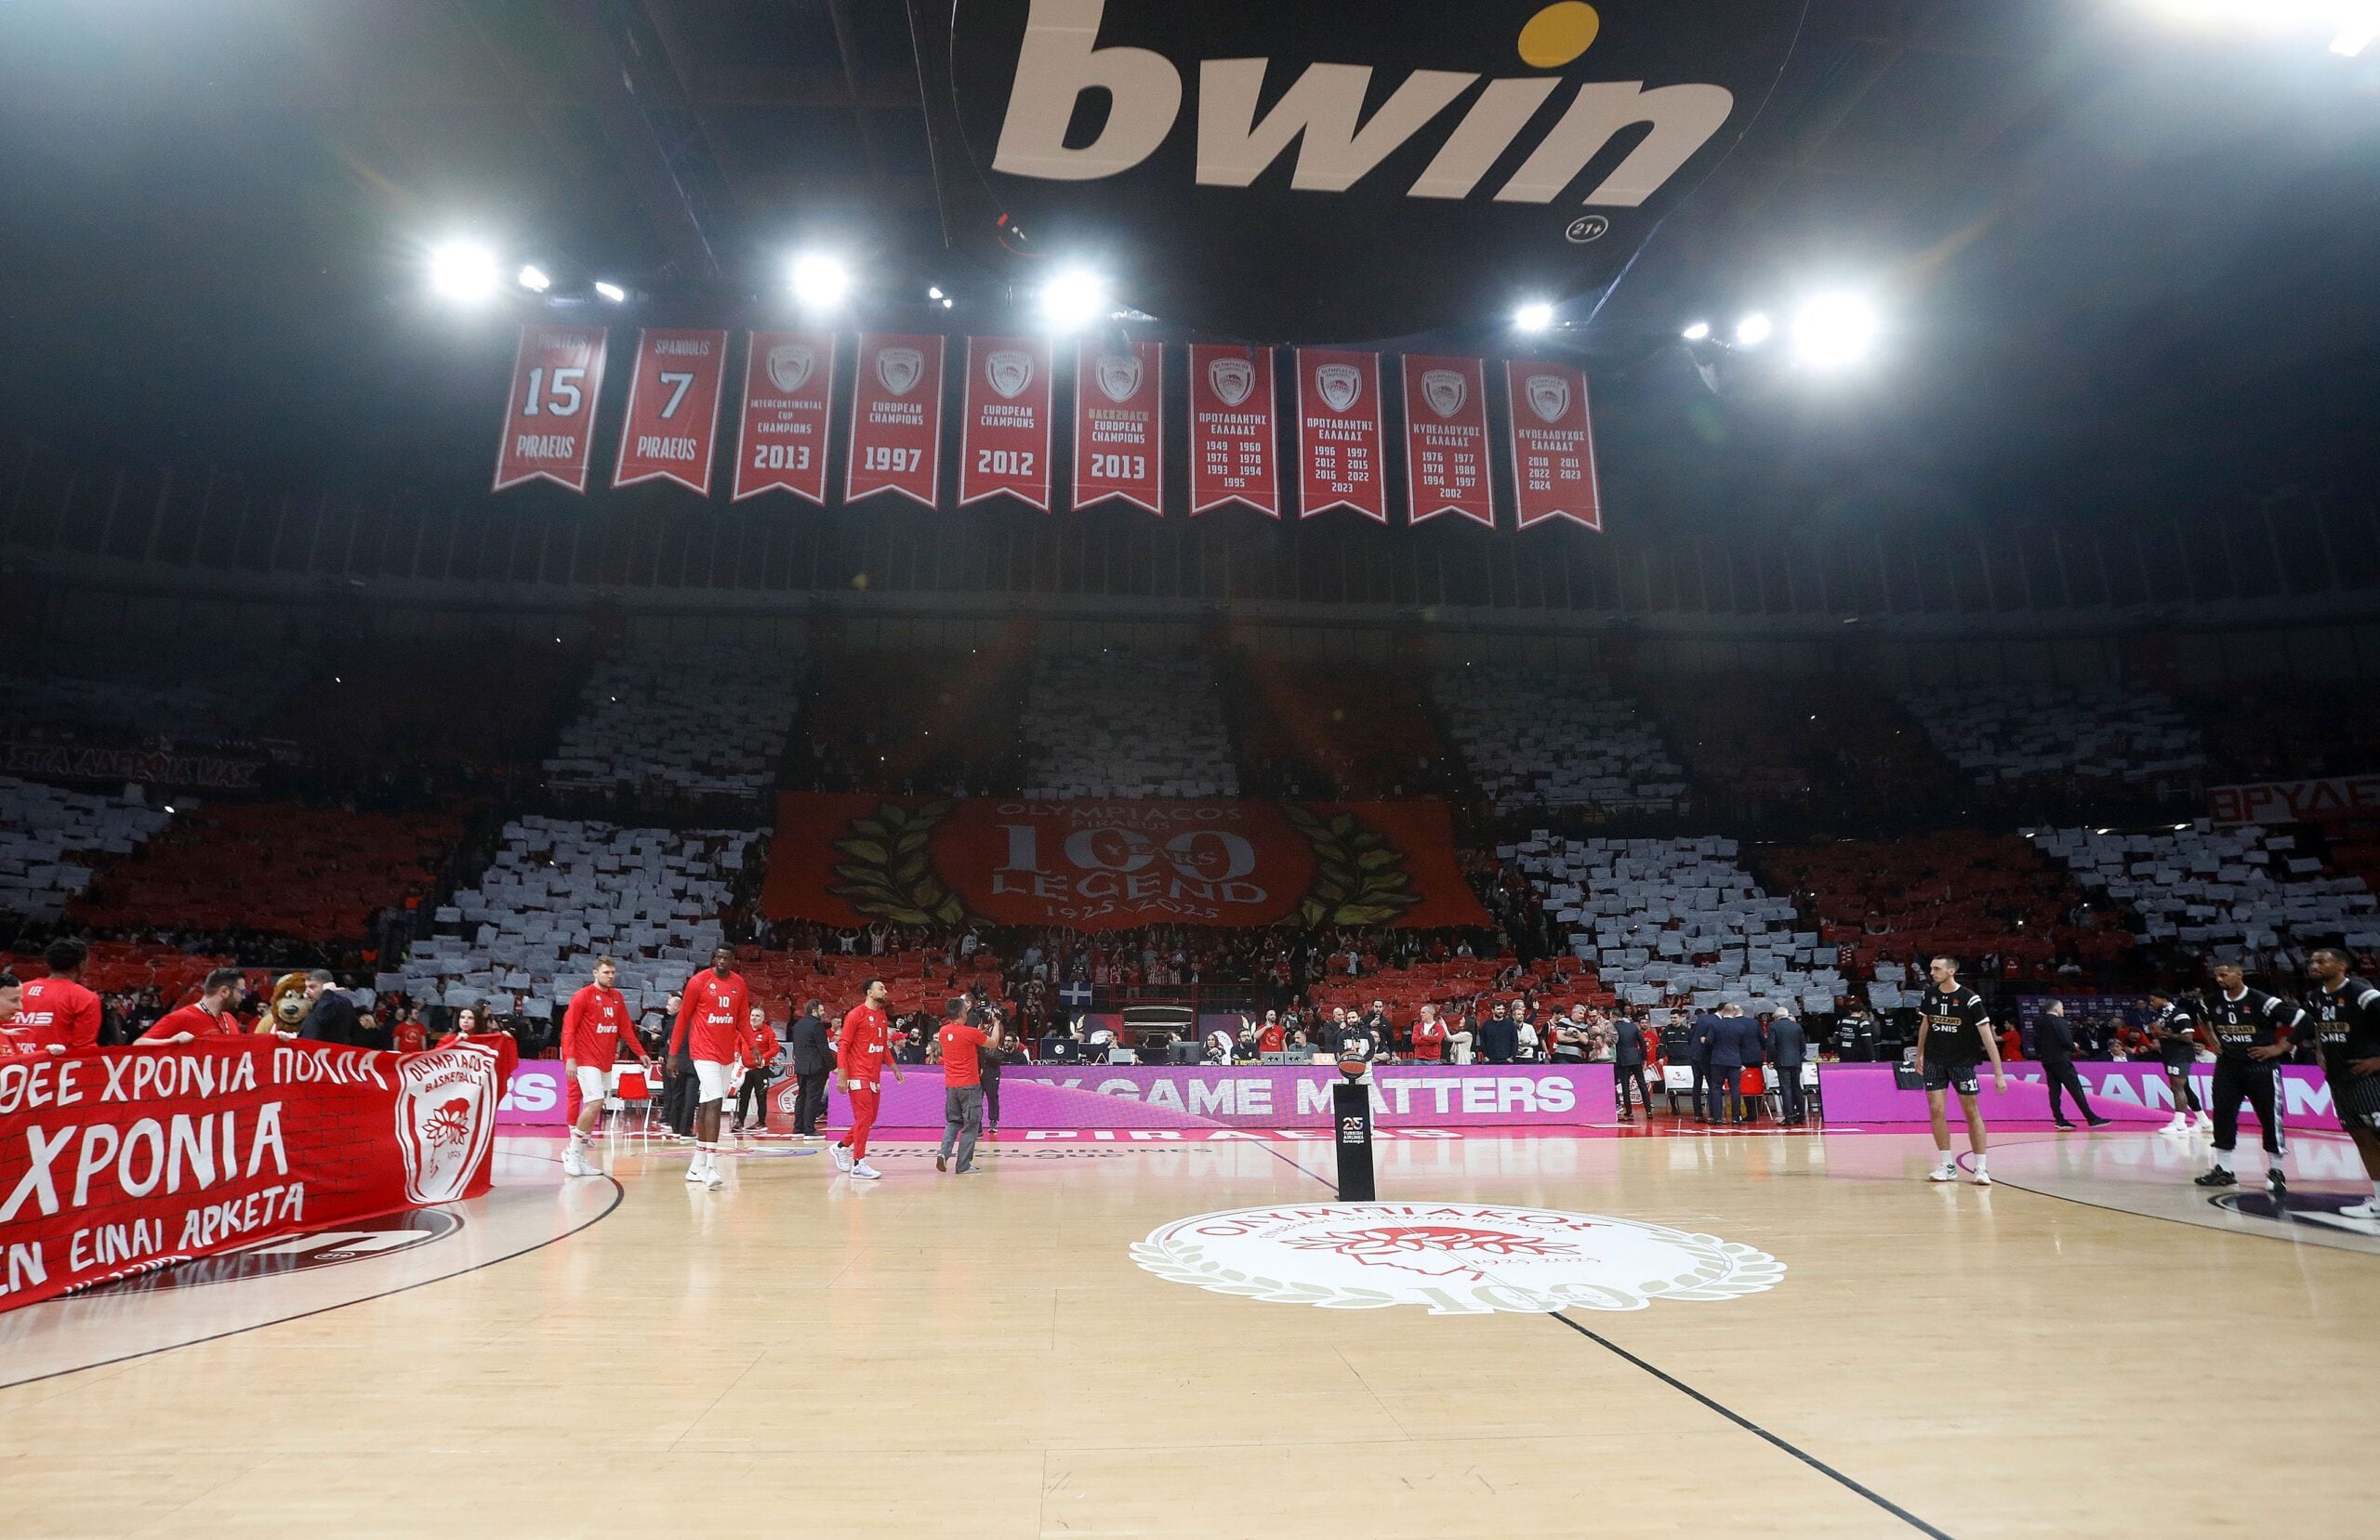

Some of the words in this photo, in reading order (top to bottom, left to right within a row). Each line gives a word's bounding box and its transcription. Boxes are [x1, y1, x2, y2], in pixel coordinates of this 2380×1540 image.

[992, 0, 1734, 207] bwin
[1572, 223, 1602, 235] 21+
[523, 367, 585, 416] 15
[659, 373, 694, 418] 7
[751, 399, 822, 410] INTERCONTINENTAL
[872, 401, 922, 414] EUROPEAN
[984, 404, 1033, 417] EUROPEAN
[778, 411, 793, 420] CUP
[869, 413, 923, 425] CHAMPIONS
[981, 415, 1035, 428] CHAMPIONS
[1199, 413, 1266, 425] ΠΡΩΤΑΘΛΗΤΗΣ
[758, 422, 812, 434] CHAMPIONS
[1095, 420, 1143, 432] EUROPEAN
[1307, 417, 1373, 430] ΠΡΩΤΑΘΛΗΤΗΣ
[1210, 425, 1255, 435] ΕΛΛΑΔΑΣ
[1319, 430, 1362, 441] ΕΛΛΑΔΑΣ
[1092, 431, 1145, 443] CHAMPIONS
[1426, 436, 1469, 446] ΕΛΛΑΔΑΣ
[516, 435, 575, 459] PIRAEUS
[636, 436, 696, 461] PIRAEUS
[1207, 441, 1228, 451] 1949
[1239, 442, 1261, 452] 1960
[1315, 446, 1336, 455] 1996
[1347, 448, 1367, 457] 1997
[754, 444, 810, 469] 2013
[865, 446, 922, 472] 1997
[1207, 453, 1228, 462] 1976
[1239, 454, 1261, 464] 1978
[1422, 452, 1443, 461] 1976
[1454, 453, 1474, 463] 1977
[1528, 456, 1548, 467] 2010
[1560, 458, 1579, 467] 2011
[978, 450, 1034, 476] 2012
[1091, 454, 1144, 479] 2013
[1315, 458, 1336, 467] 2012
[1347, 459, 1368, 469] 2015
[1207, 465, 1228, 474] 1993
[1239, 467, 1262, 476] 1994
[1316, 469, 1336, 480] 2016
[1347, 471, 1368, 481] 2022
[1422, 464, 1444, 473] 1978
[1455, 465, 1475, 475] 1980
[1529, 468, 1550, 478] 2022
[1560, 469, 1580, 480] 2023
[1224, 478, 1245, 487] 1995
[1331, 482, 1353, 493] 2023
[1423, 476, 1445, 485] 1994
[1456, 477, 1475, 487] 1997
[1529, 480, 1551, 490] 2024
[1440, 488, 1461, 498] 2002
[997, 804, 1242, 821] OLYMPIACOS
[1072, 819, 1170, 830] PIRAEUS
[993, 824, 1256, 882] 100
[992, 872, 1267, 904] LEGEND
[28, 986, 44, 996] LEE
[719, 996, 730, 1007] 10
[602, 1007, 615, 1018] 14
[1940, 1004, 1949, 1015] 11
[11, 1012, 54, 1025] MS
[707, 1013, 734, 1024] bwin
[2228, 1012, 2237, 1024] 0
[596, 1022, 617, 1033] bwin
[100, 1051, 257, 1103] ΧΡΟΝΙΑ
[273, 1047, 387, 1090] ΠΟΛΛΑ
[1097, 1078, 1274, 1114] GAME
[1342, 1116, 1364, 1130] 25
[0, 1101, 288, 1222] ΧΡΟΝΙΑ
[70, 1218, 162, 1272] ΕΙΝΑΙ
[178, 1181, 304, 1251] ΑΡΚΕΤΑ
[1197, 1206, 1612, 1236] ΟΛΥΜΠΙΑΚΟΣ
